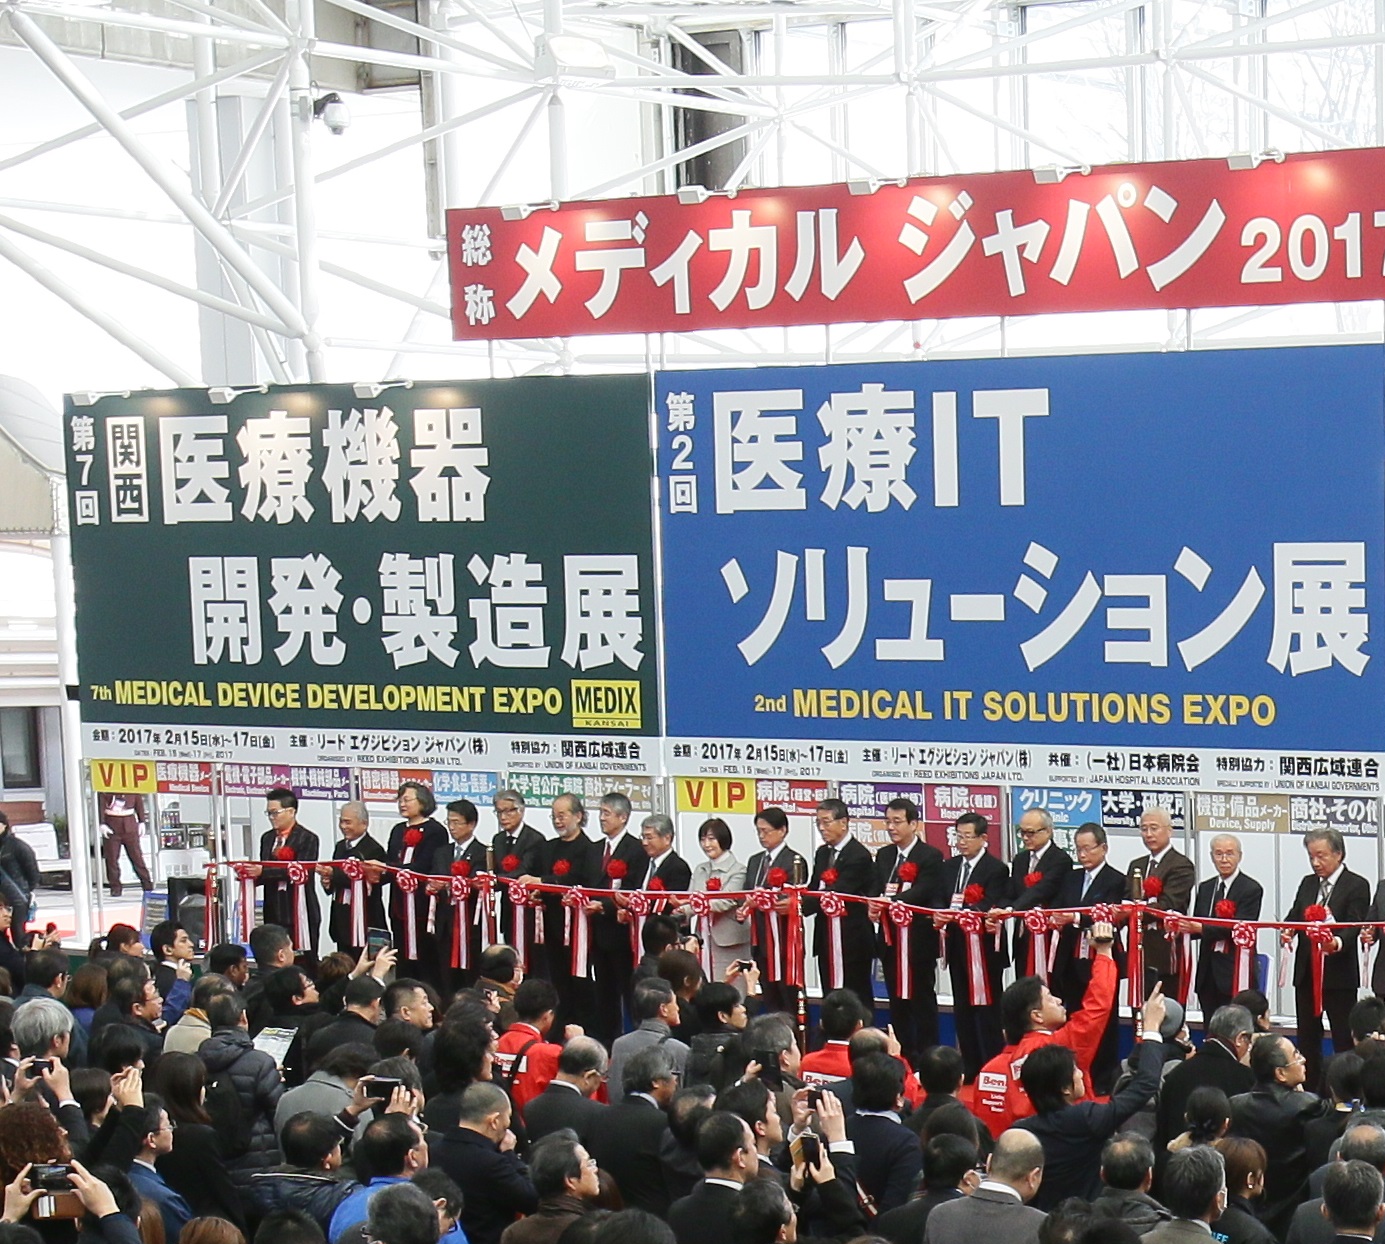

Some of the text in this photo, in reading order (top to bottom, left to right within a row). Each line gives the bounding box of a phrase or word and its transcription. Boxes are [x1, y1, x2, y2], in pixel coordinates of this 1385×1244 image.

[461, 224, 494, 325] 総称
[506, 208, 865, 320] メディカル
[899, 182, 1226, 304] ジャパン
[71, 415, 99, 527] 第7回
[112, 422, 141, 516] 関西
[157, 405, 490, 525] 医療機器
[667, 391, 698, 513] 第2回
[713, 383, 1050, 514] 医療IT
[188, 552, 644, 672] 開発・製造展
[720, 541, 1370, 677] ソリューション展
[90, 680, 563, 715] 7th MEDICAL DEVICE DEVELOPMENT EXPO
[575, 686, 638, 715] MEDIX
[584, 720, 629, 728] KANSAI
[754, 689, 1276, 728] 2nd MEDICAL IT SOLUTIONS EXPO
[98, 763, 148, 788] VIP
[561, 740, 642, 760] 関西広域連合
[1280, 756, 1379, 778] 関西広域連合
[685, 780, 746, 809] VIP
[1244, 818, 1276, 832] Supply
